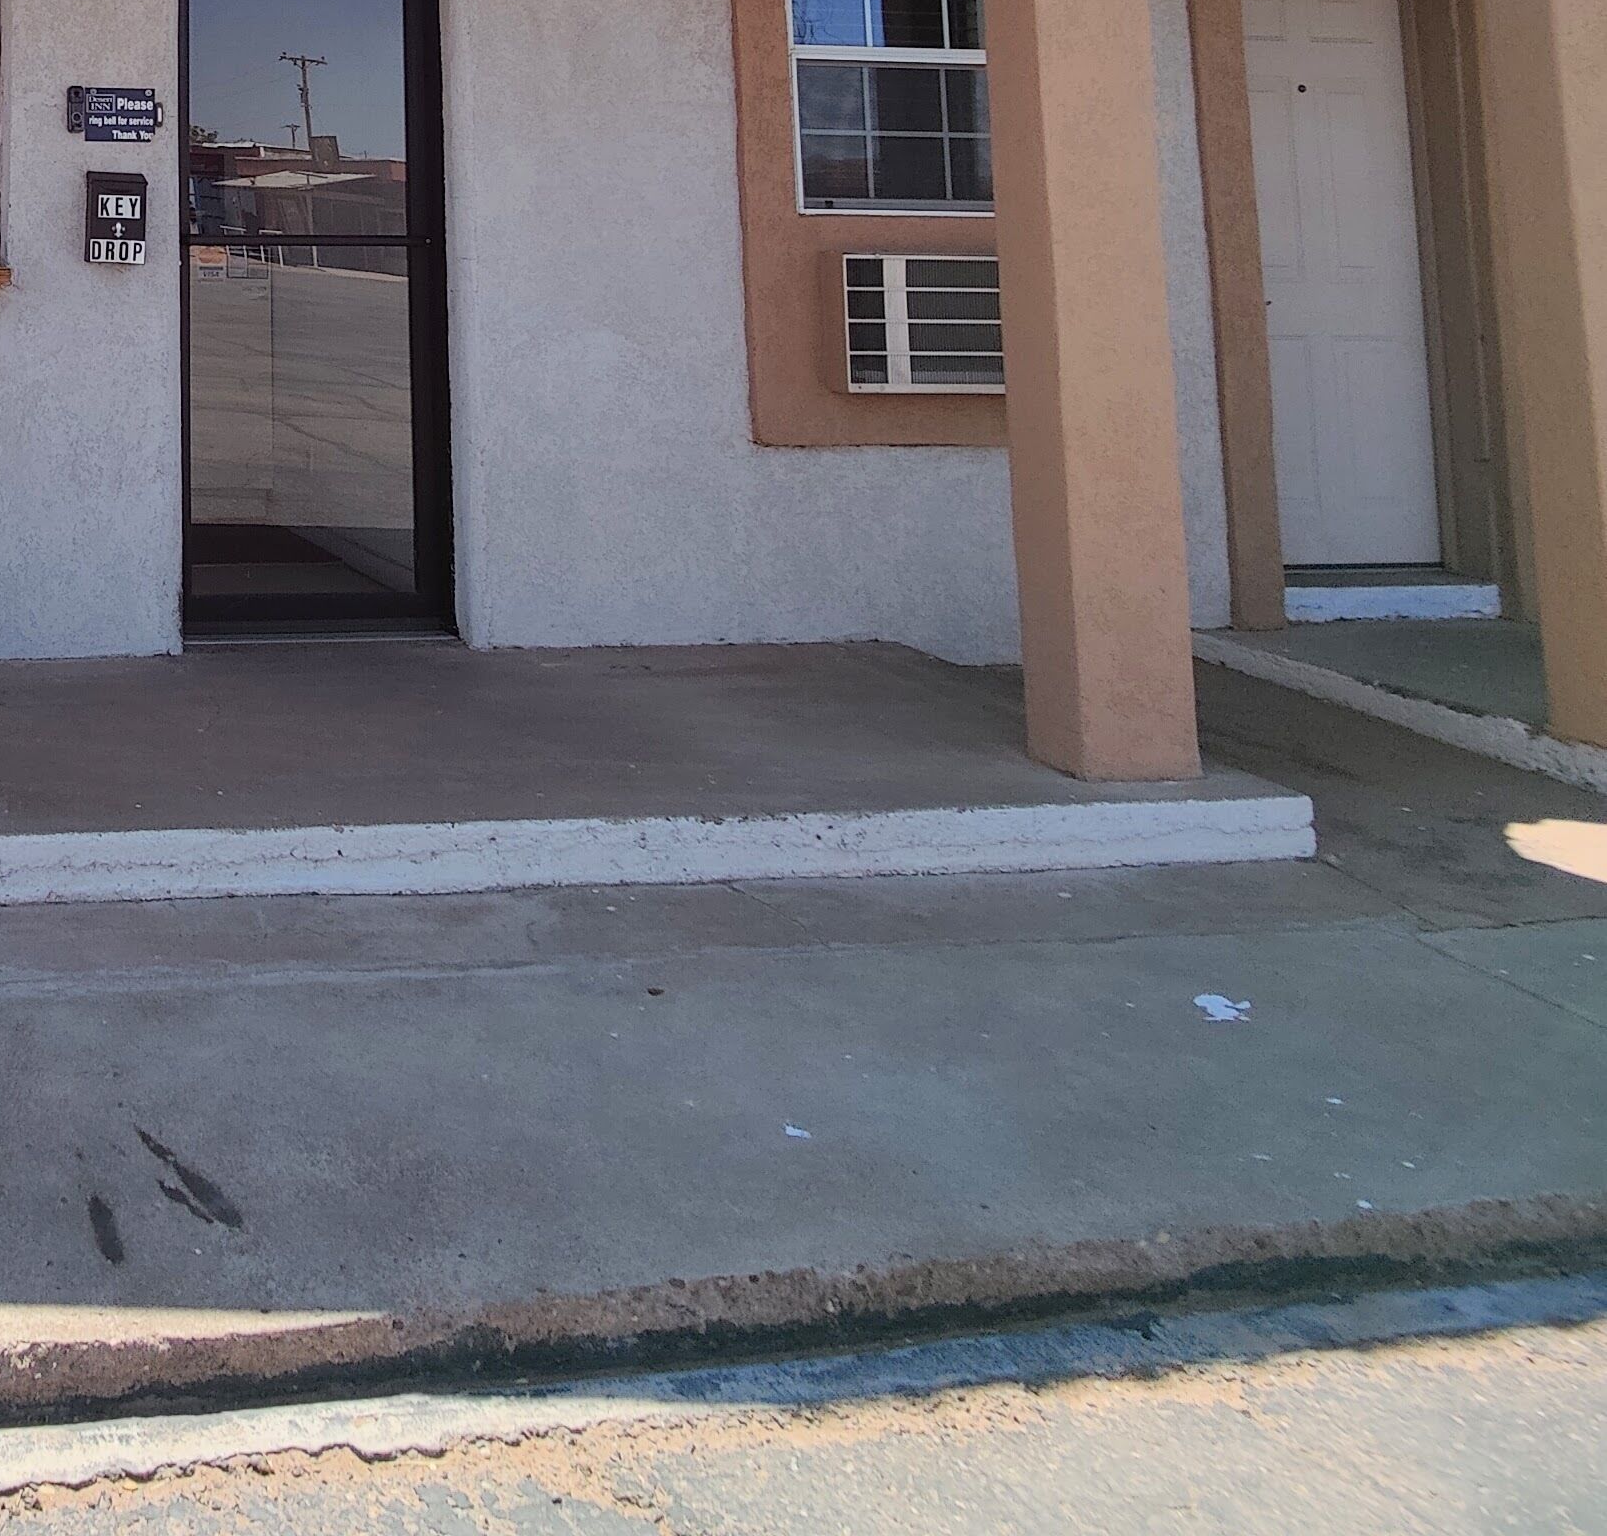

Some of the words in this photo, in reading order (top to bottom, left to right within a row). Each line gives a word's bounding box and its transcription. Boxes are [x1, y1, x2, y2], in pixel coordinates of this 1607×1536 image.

[91, 102, 111, 110] INN
[116, 97, 154, 111] Please
[88, 115, 103, 127] ring
[103, 115, 117, 125] bell
[117, 115, 128, 125] for
[128, 116, 154, 126] service
[112, 129, 138, 140] Thank
[99, 196, 139, 217] KEY
[91, 241, 143, 262] DROP
